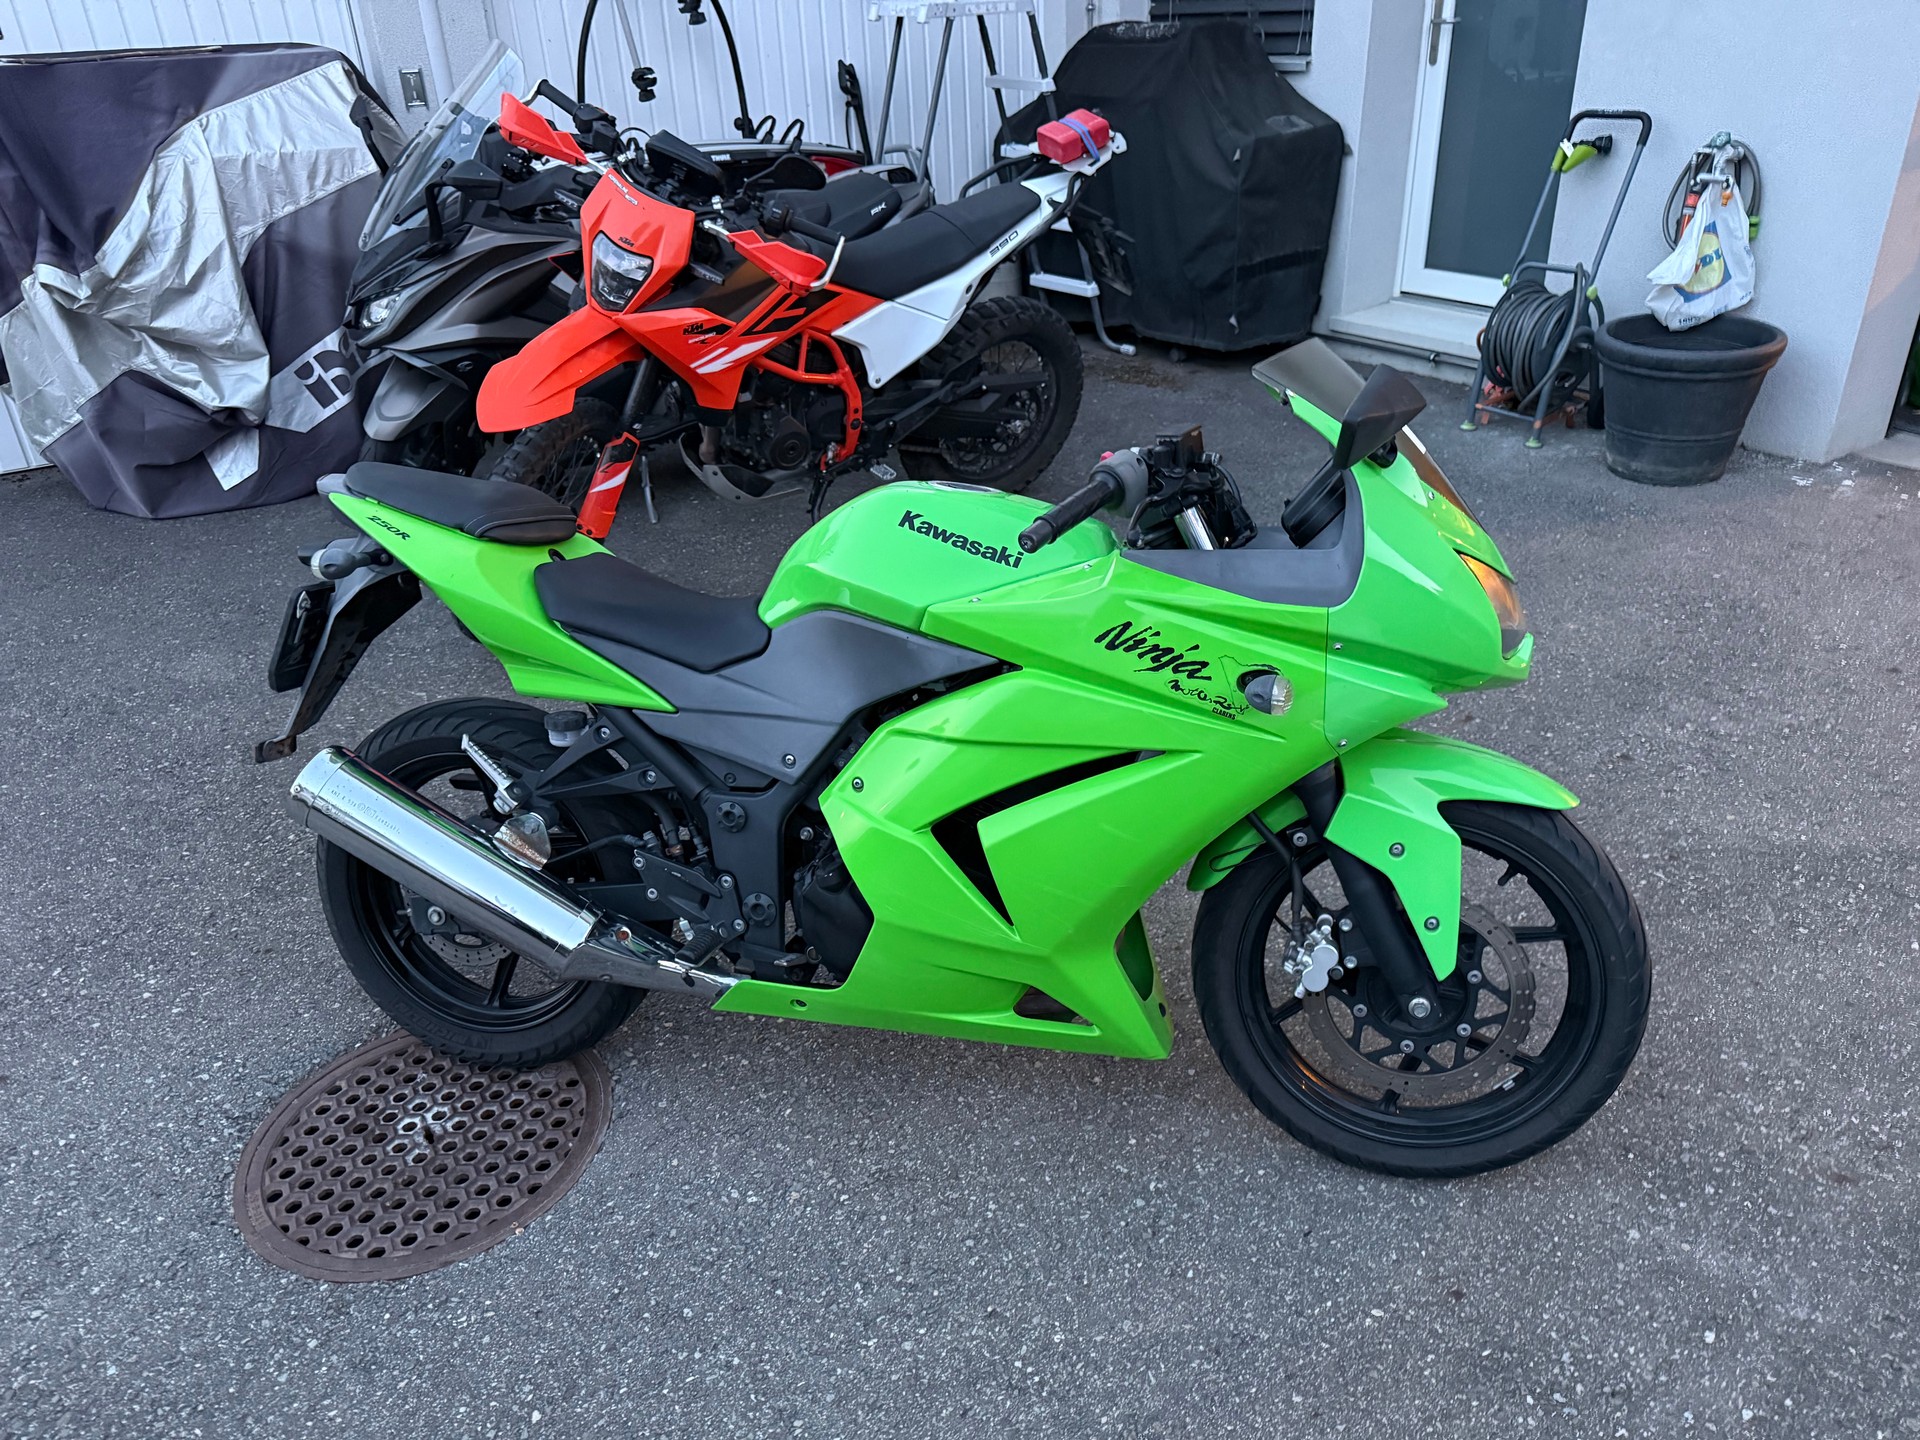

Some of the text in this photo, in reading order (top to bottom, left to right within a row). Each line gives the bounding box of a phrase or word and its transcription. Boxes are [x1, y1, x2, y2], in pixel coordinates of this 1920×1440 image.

[618, 236, 635, 247] KTM
[989, 230, 1018, 257] 390
[683, 322, 704, 335] KTM
[366, 515, 411, 541] 250R
[898, 509, 1024, 569] Kawasaki
[1094, 621, 1212, 681] Ninja
